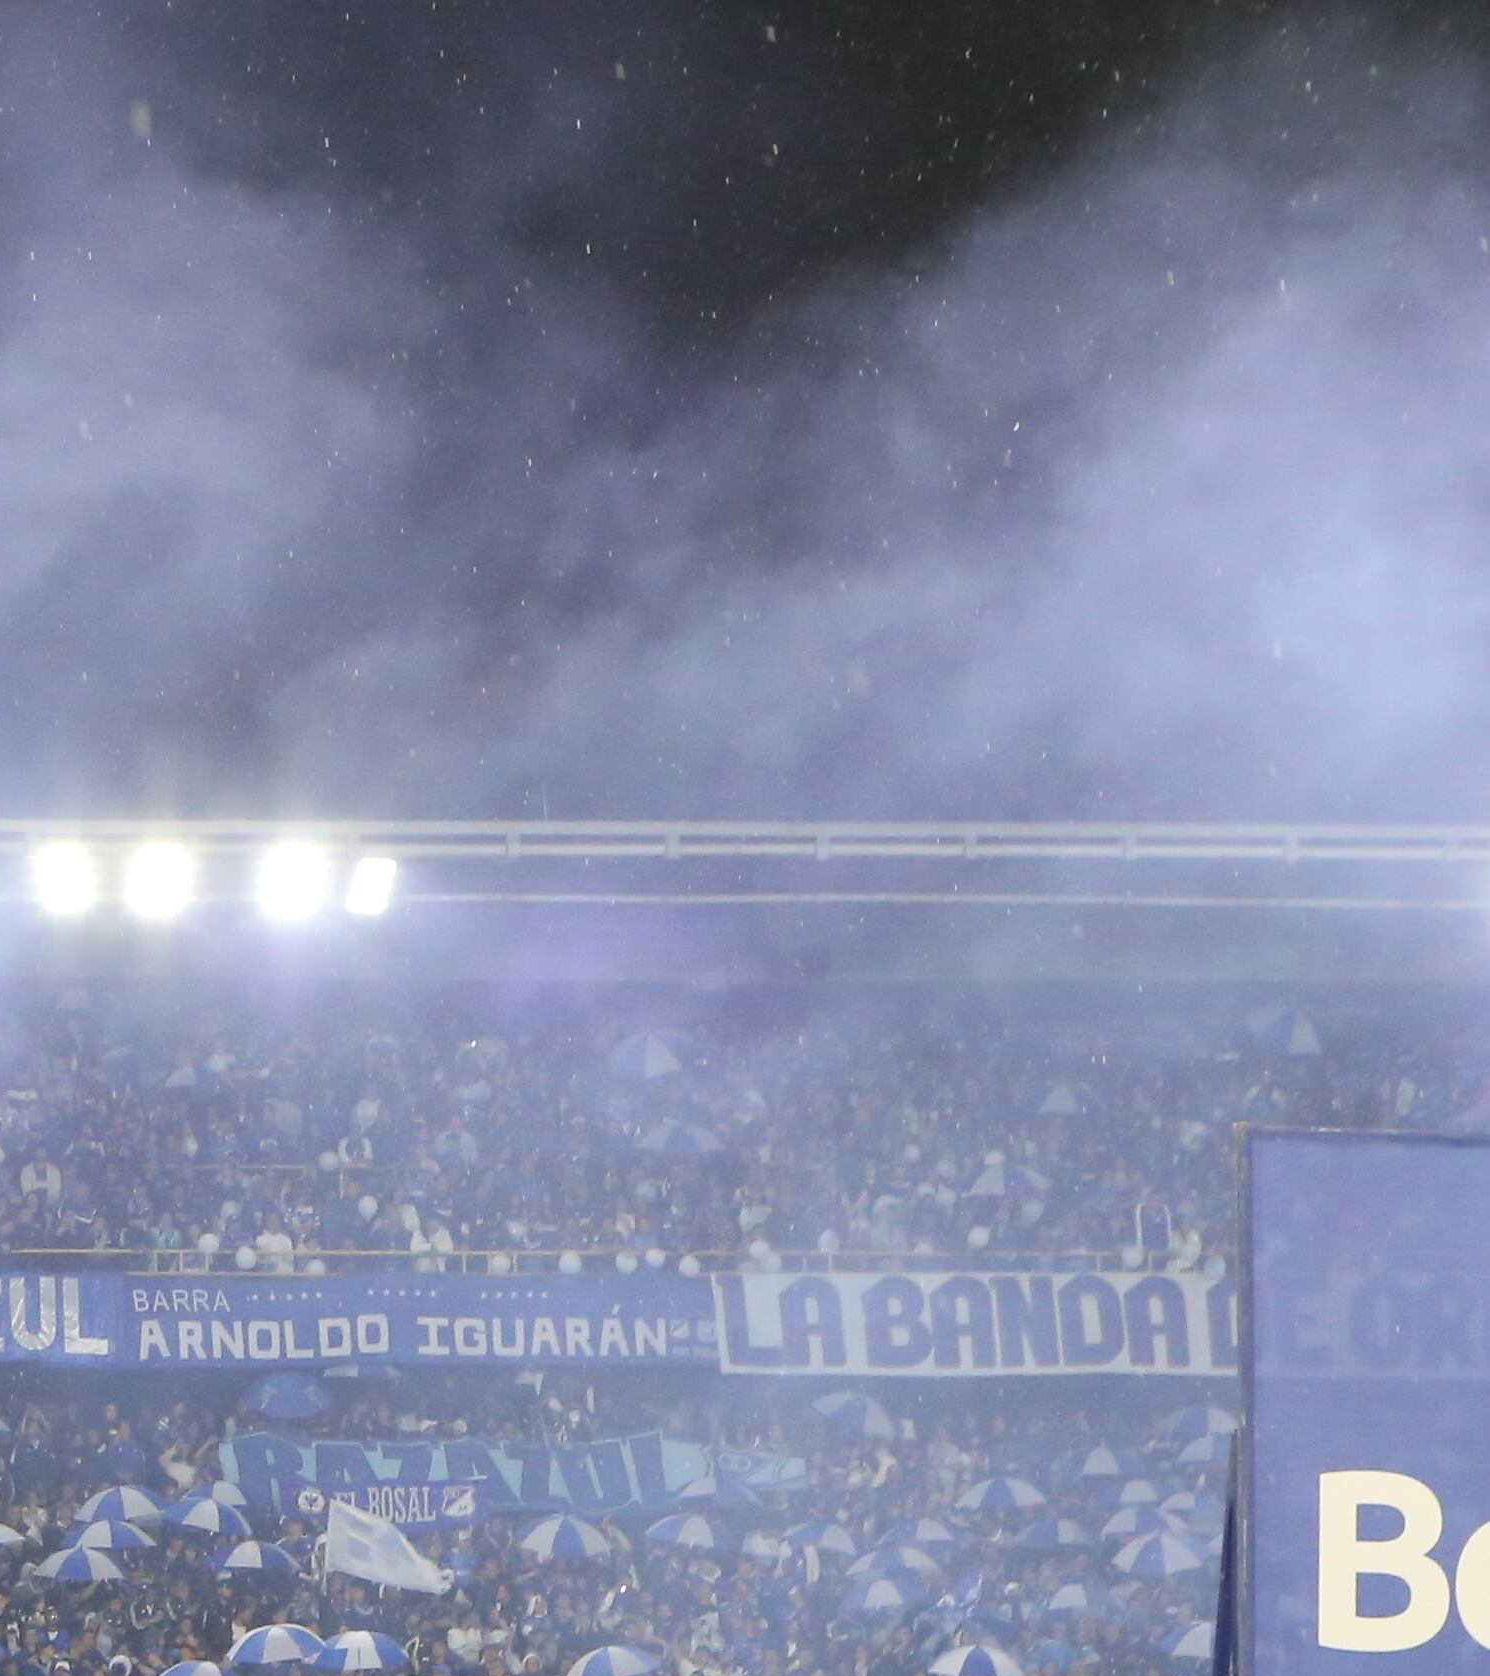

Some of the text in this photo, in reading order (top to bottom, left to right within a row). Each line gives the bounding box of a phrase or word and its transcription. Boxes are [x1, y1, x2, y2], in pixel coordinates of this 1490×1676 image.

[133, 1289, 231, 1314] BARRA
[719, 1274, 846, 1367] LA
[863, 1274, 1190, 1367] BANDA
[140, 1304, 669, 1361] ARNOLDO IGUARÁN
